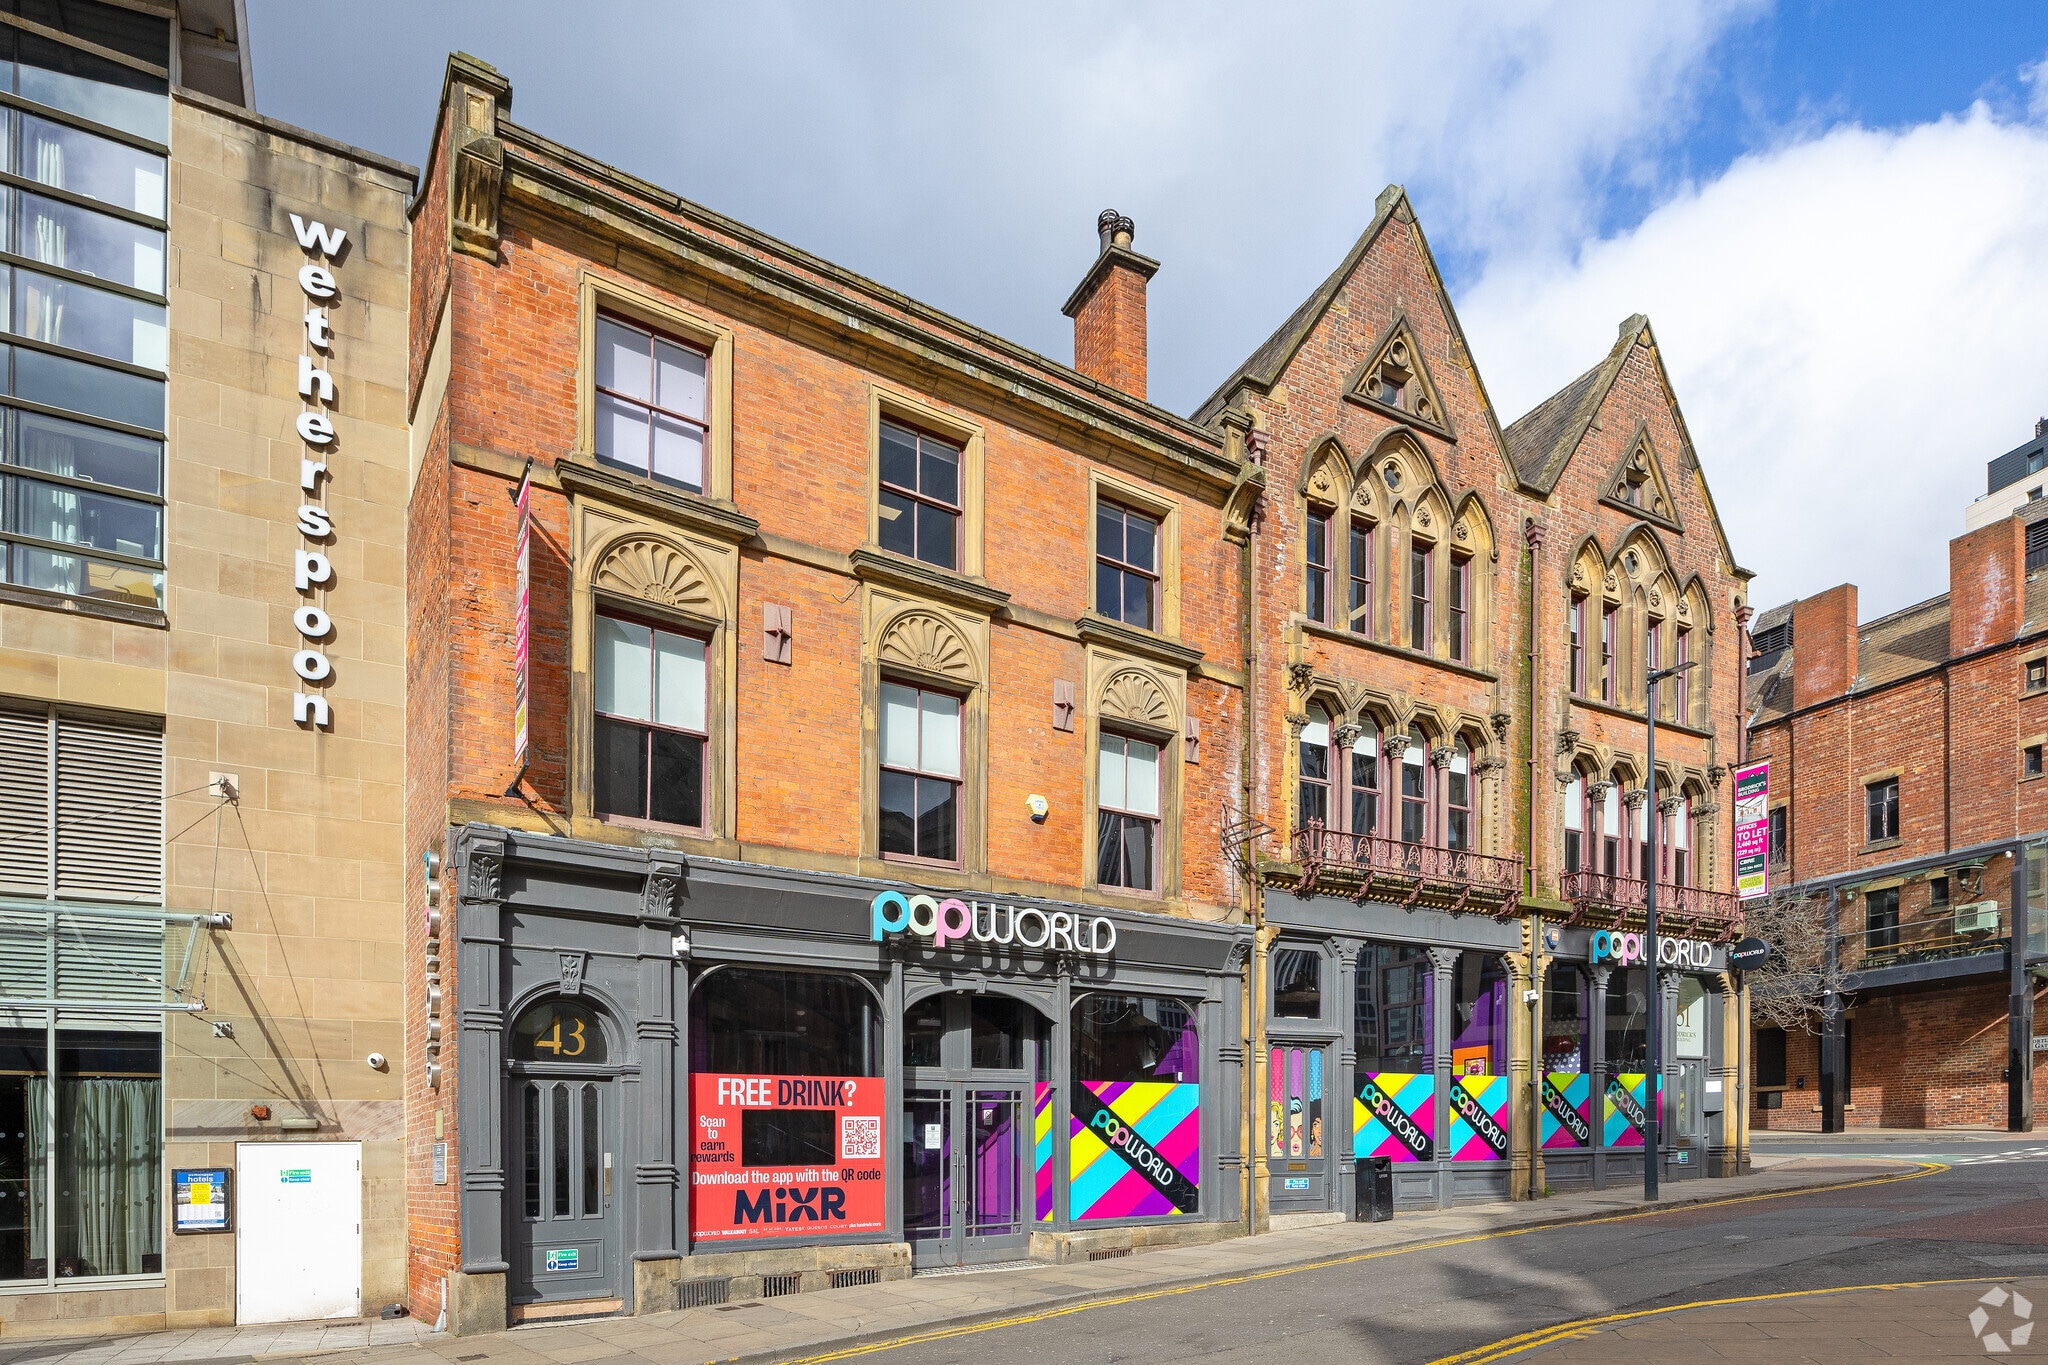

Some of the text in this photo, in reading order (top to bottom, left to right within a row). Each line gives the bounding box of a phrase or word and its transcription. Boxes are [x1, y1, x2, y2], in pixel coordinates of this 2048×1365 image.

[288, 211, 347, 726] wetherspoon
[1737, 823, 1757, 831] OFFICES
[1737, 826, 1768, 841] TO LET
[1737, 840, 1751, 849] 2,460
[534, 1015, 585, 1056] 43
[717, 1077, 857, 1107] FREE DRINK?
[699, 1115, 726, 1128] Scan
[707, 1128, 718, 1140] to
[700, 1140, 725, 1151] earn
[690, 1150, 735, 1163] rewards
[692, 1168, 881, 1185] Download the app with the QR code
